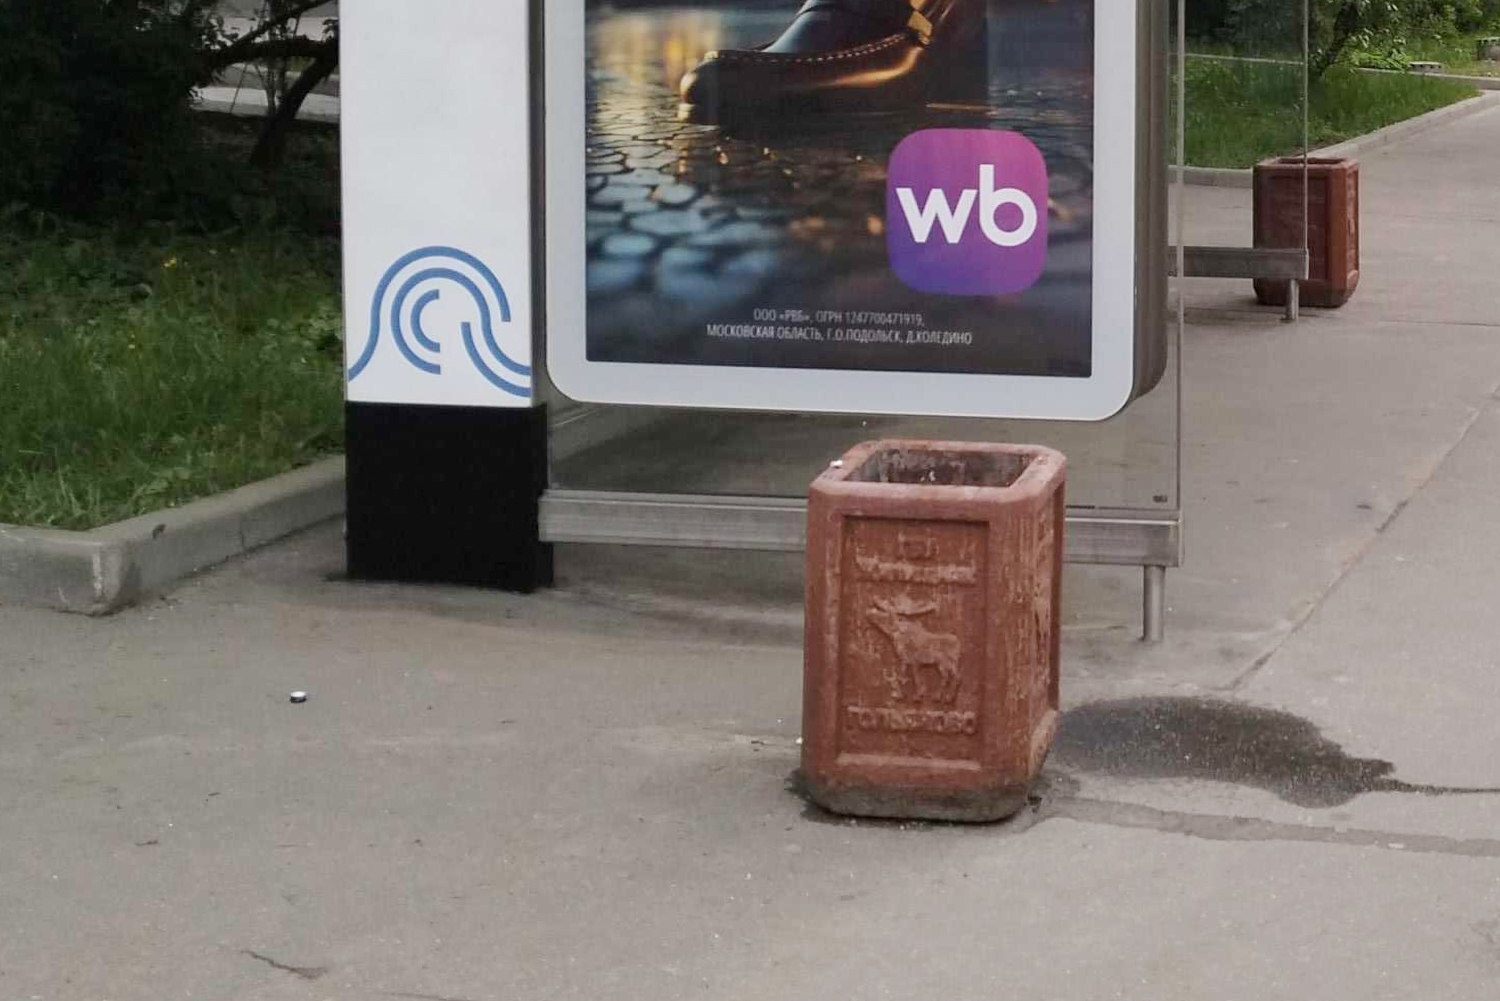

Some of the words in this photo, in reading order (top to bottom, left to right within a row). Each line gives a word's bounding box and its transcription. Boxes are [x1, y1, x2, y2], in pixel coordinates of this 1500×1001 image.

[895, 164, 1038, 247] wb
[752, 307, 777, 321] ООО
[815, 310, 843, 323] ОГРН
[706, 323, 775, 339] МОСКОВСКАЯ
